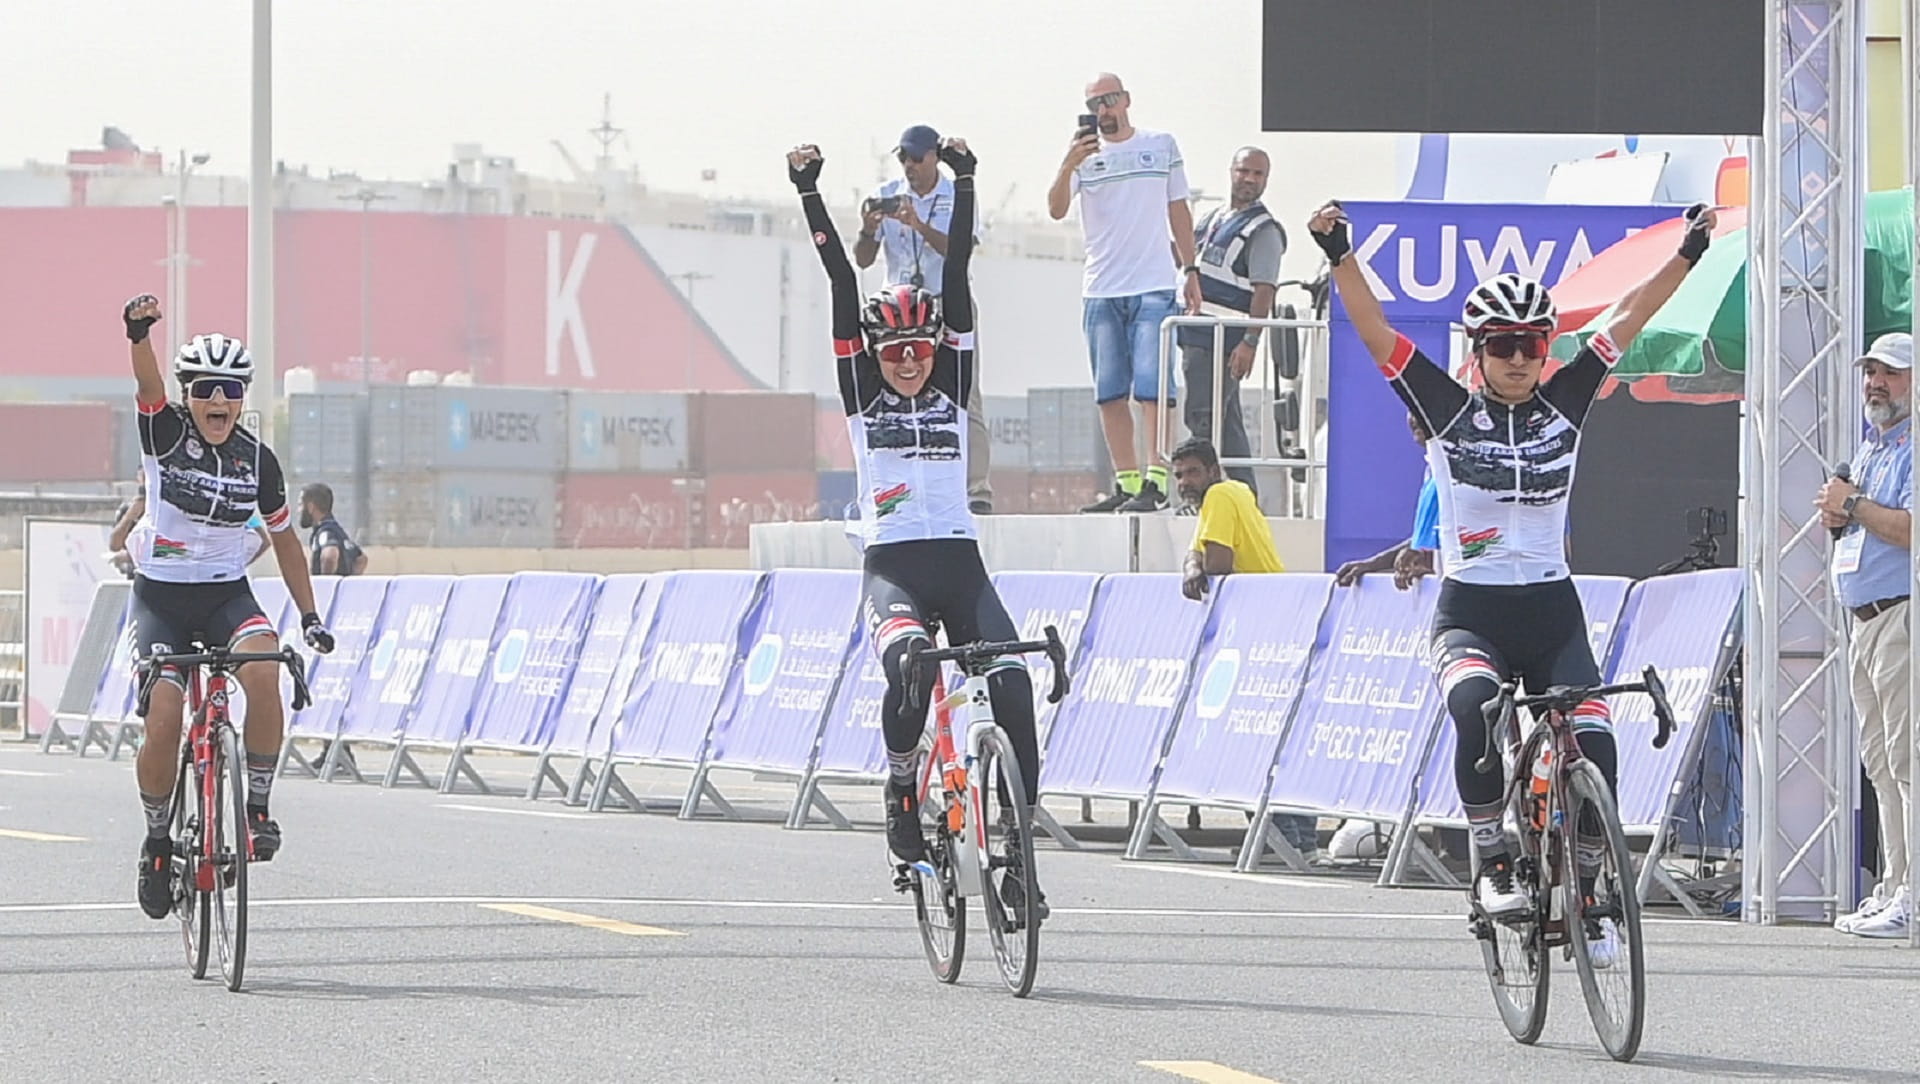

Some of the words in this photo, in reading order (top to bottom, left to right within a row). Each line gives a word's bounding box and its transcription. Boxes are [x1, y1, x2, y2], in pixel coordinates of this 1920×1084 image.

[1336, 224, 1643, 302] KUWA
[546, 229, 597, 378] K
[469, 411, 541, 443] MAERSK
